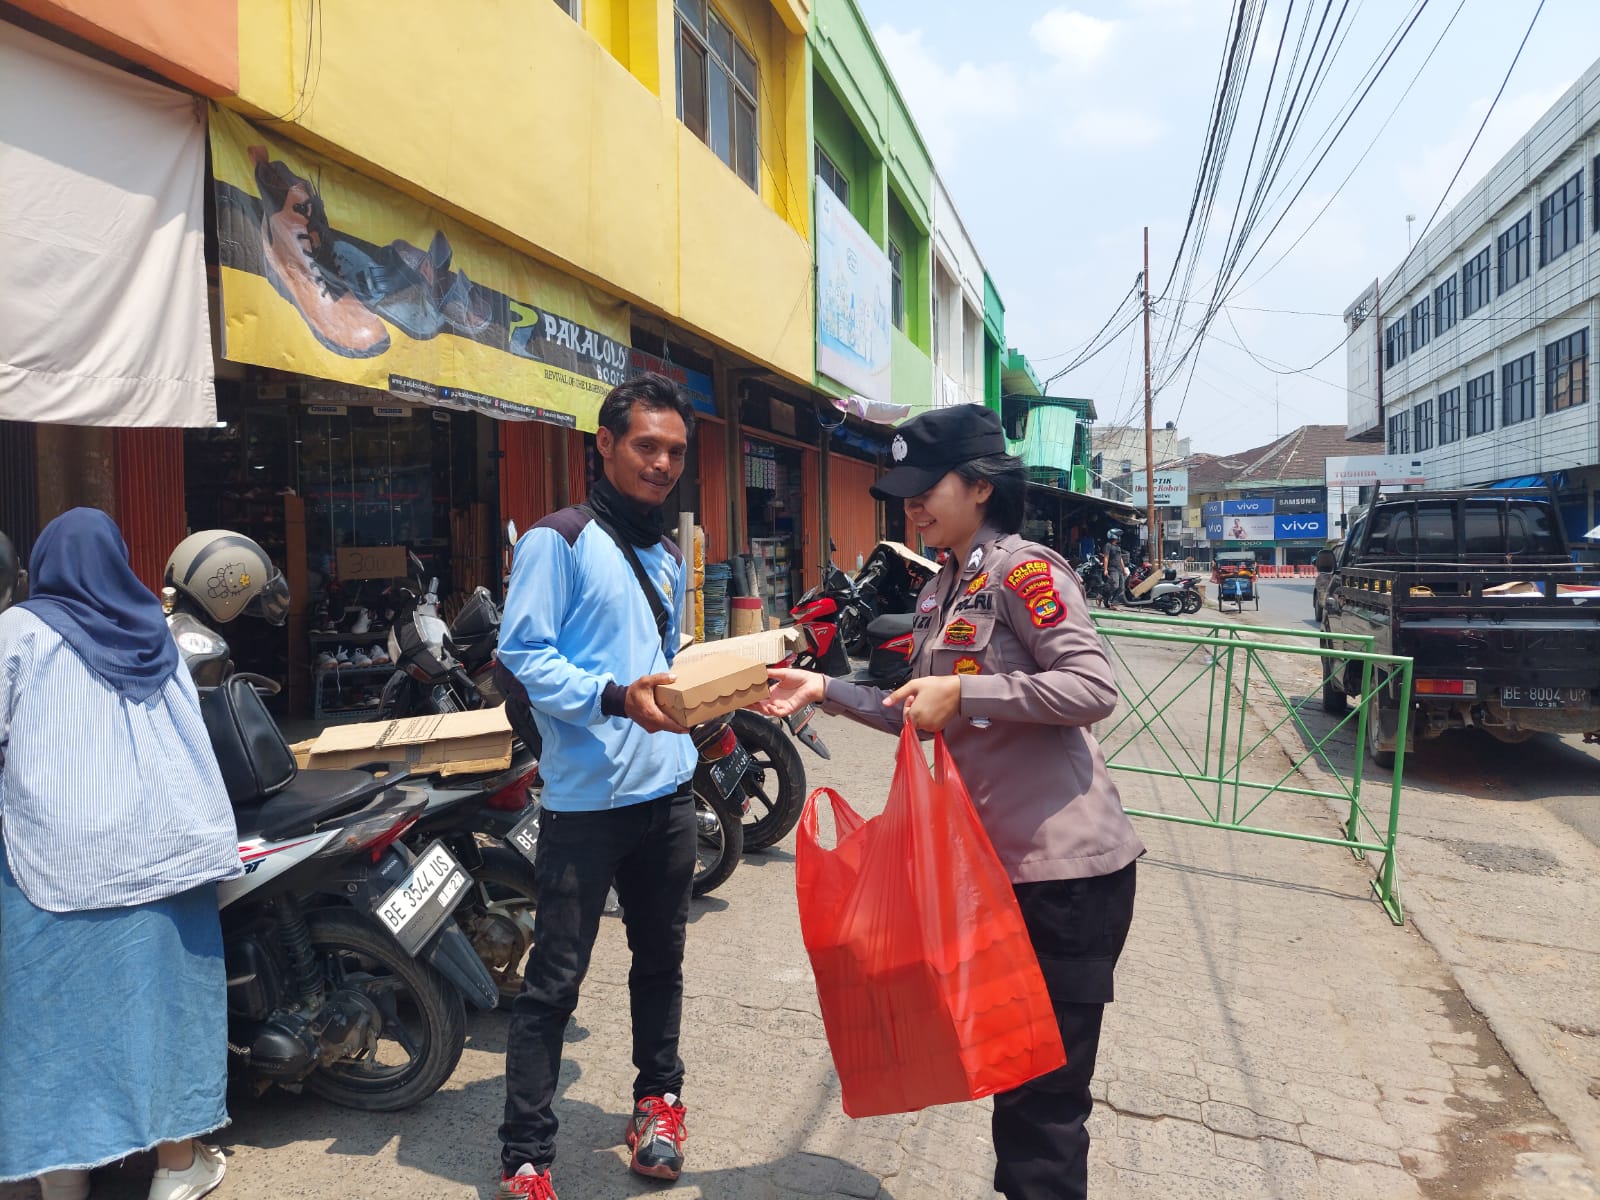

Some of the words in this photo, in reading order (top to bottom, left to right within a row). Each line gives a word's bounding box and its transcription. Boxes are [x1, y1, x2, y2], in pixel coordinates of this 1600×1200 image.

[543, 313, 626, 370] PAKALOLO
[544, 368, 569, 385] REVIVAL
[568, 376, 576, 387] OF
[596, 363, 625, 386] BOOTS
[1236, 502, 1260, 510] vivo
[1279, 497, 1317, 505] SAMSUNG
[1208, 522, 1222, 533] vivo
[1281, 520, 1319, 531] vivo
[1504, 687, 1521, 700] BE
[1529, 687, 1560, 701] 8004
[516, 829, 537, 850] BE
[384, 901, 406, 928] BE
[403, 870, 435, 908] 3544
[429, 855, 450, 877] US
